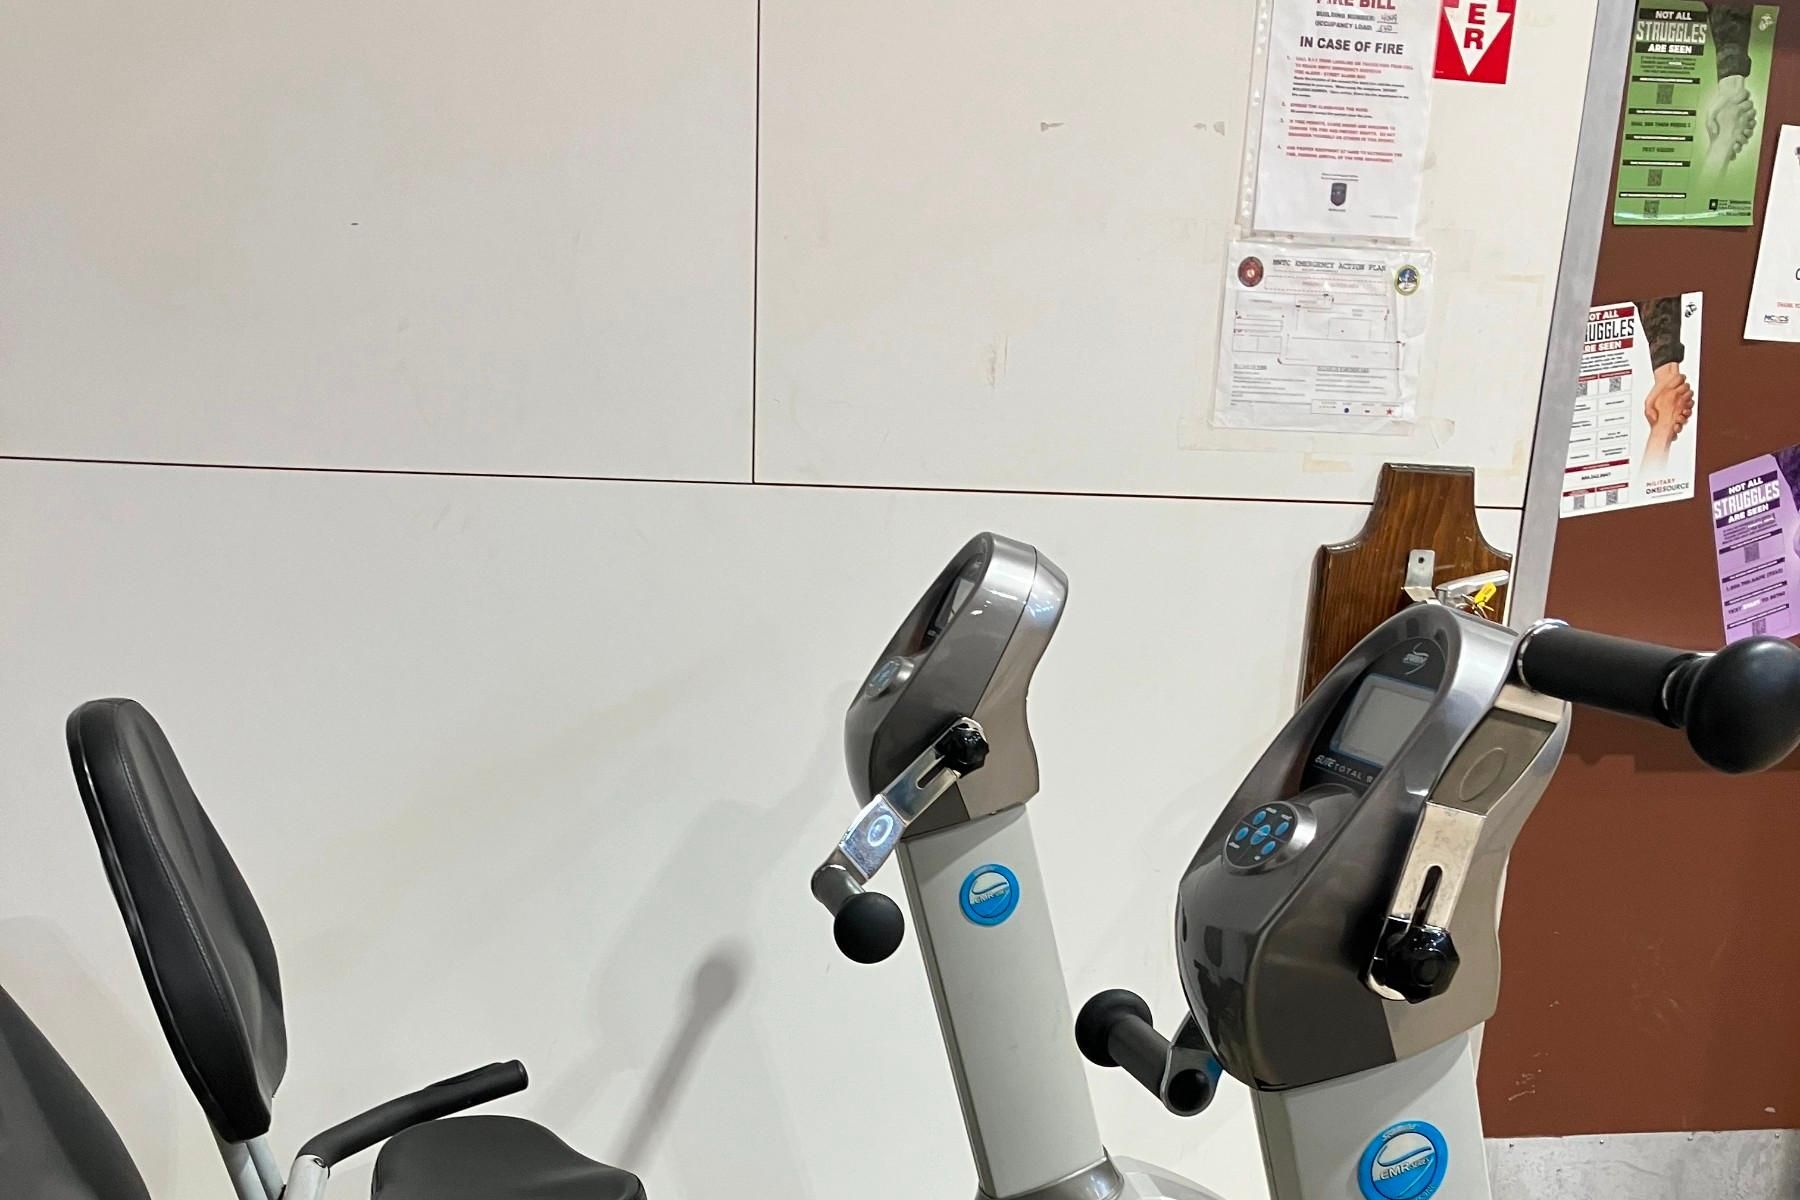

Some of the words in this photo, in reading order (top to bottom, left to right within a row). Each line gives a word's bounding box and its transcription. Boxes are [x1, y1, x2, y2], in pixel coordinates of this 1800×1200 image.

[1655, 10, 1674, 20] NOT
[1675, 12, 1692, 21] ALL
[1636, 20, 1708, 44] STRUGGLES
[1299, 36, 1314, 48] IN
[1317, 37, 1351, 51] CASE
[1354, 41, 1371, 52] OF
[1374, 42, 1404, 55] FIRE
[1647, 43, 1667, 53] ARE
[1668, 44, 1693, 54] SEEN
[1368, 264, 1386, 273] PLAN
[1603, 309, 1620, 319] ALL
[1598, 340, 1622, 352] SEEN
[1646, 478, 1675, 488] MILITARY
[1728, 482, 1747, 495] NOT
[1747, 477, 1764, 487] ALL
[1713, 480, 1780, 520] STRUGGLES
[1728, 511, 1746, 524] ARE
[1747, 503, 1769, 518] SEEN
[1334, 763, 1362, 780] TOTAL
